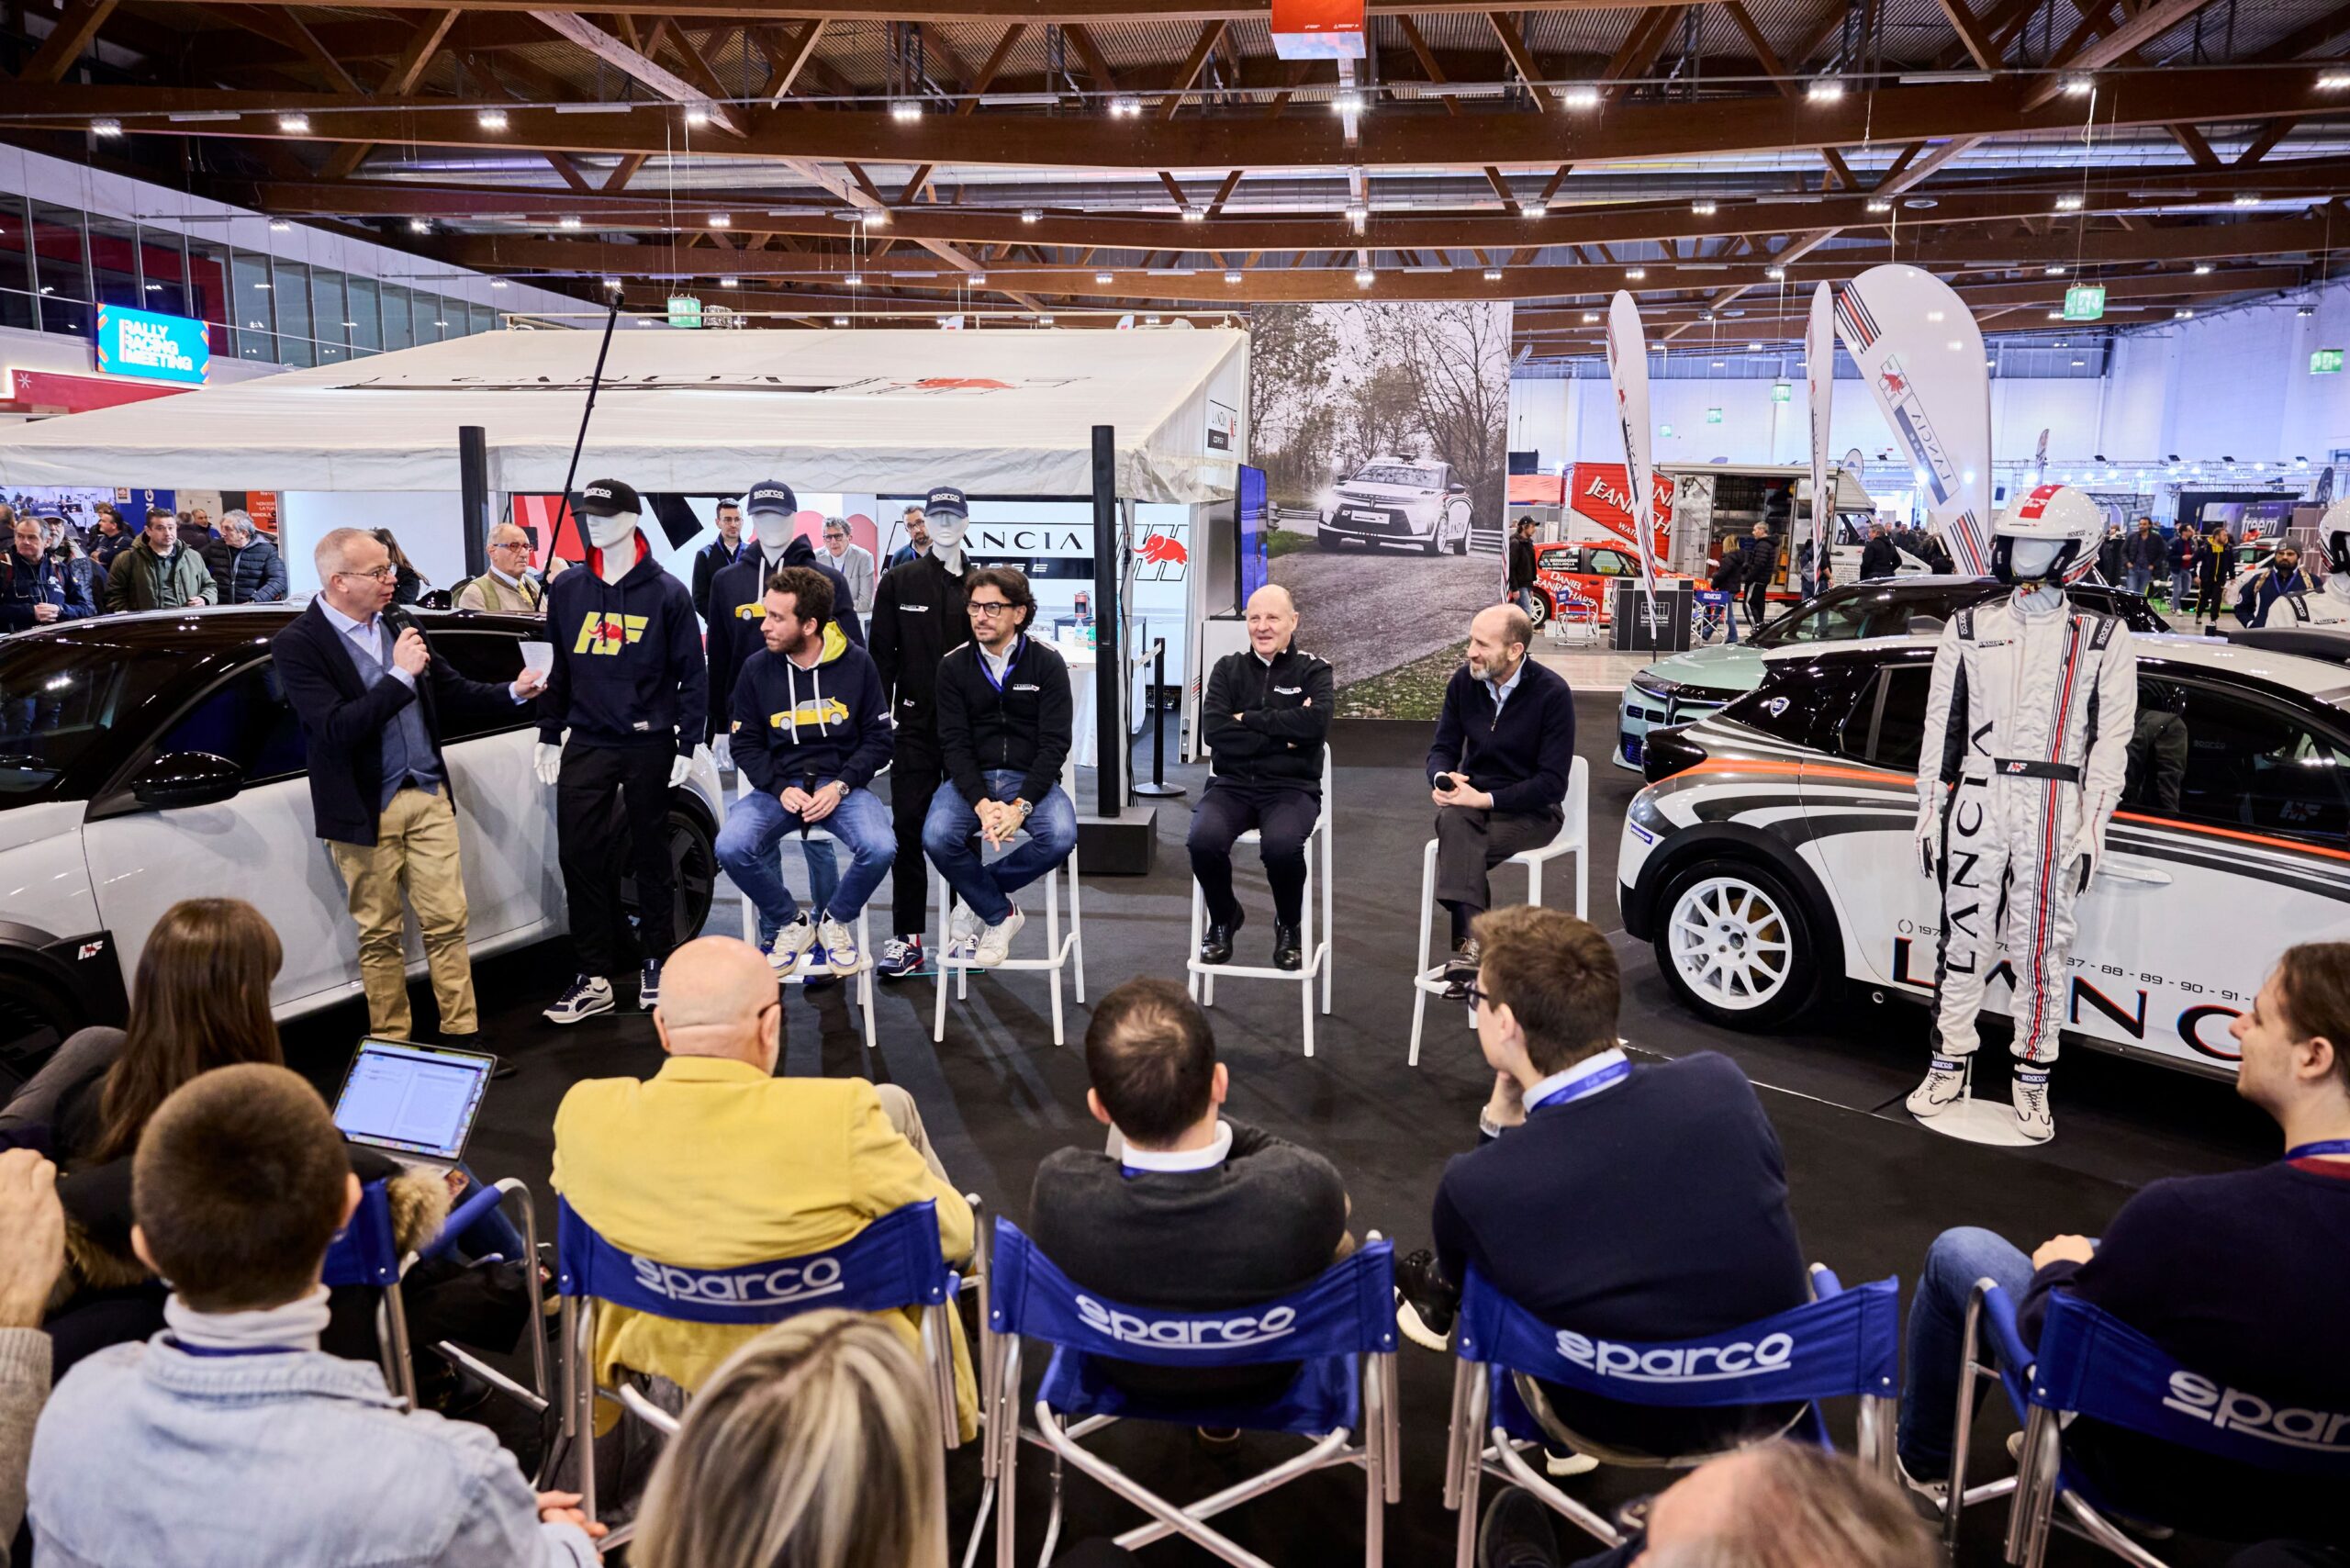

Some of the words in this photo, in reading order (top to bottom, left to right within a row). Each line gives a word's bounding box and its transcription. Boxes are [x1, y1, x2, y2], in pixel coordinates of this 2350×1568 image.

[124, 319, 169, 339] RALLY
[124, 332, 179, 355] RACING
[124, 350, 193, 371] MEETING
[753, 488, 785, 500] sparco
[930, 492, 960, 503] sparco
[1550, 571, 1582, 591] DANIEL
[2096, 618, 2115, 644] sparco
[1945, 720, 1993, 975] LANCIA
[2101, 964, 2123, 977] 88
[2140, 973, 2163, 985] 89
[2180, 980, 2203, 994] 90
[2221, 990, 2239, 1002] 91
[632, 1254, 845, 1305] sparco
[1075, 1294, 1296, 1350] sparco
[1556, 1329, 1794, 1383] sparco
